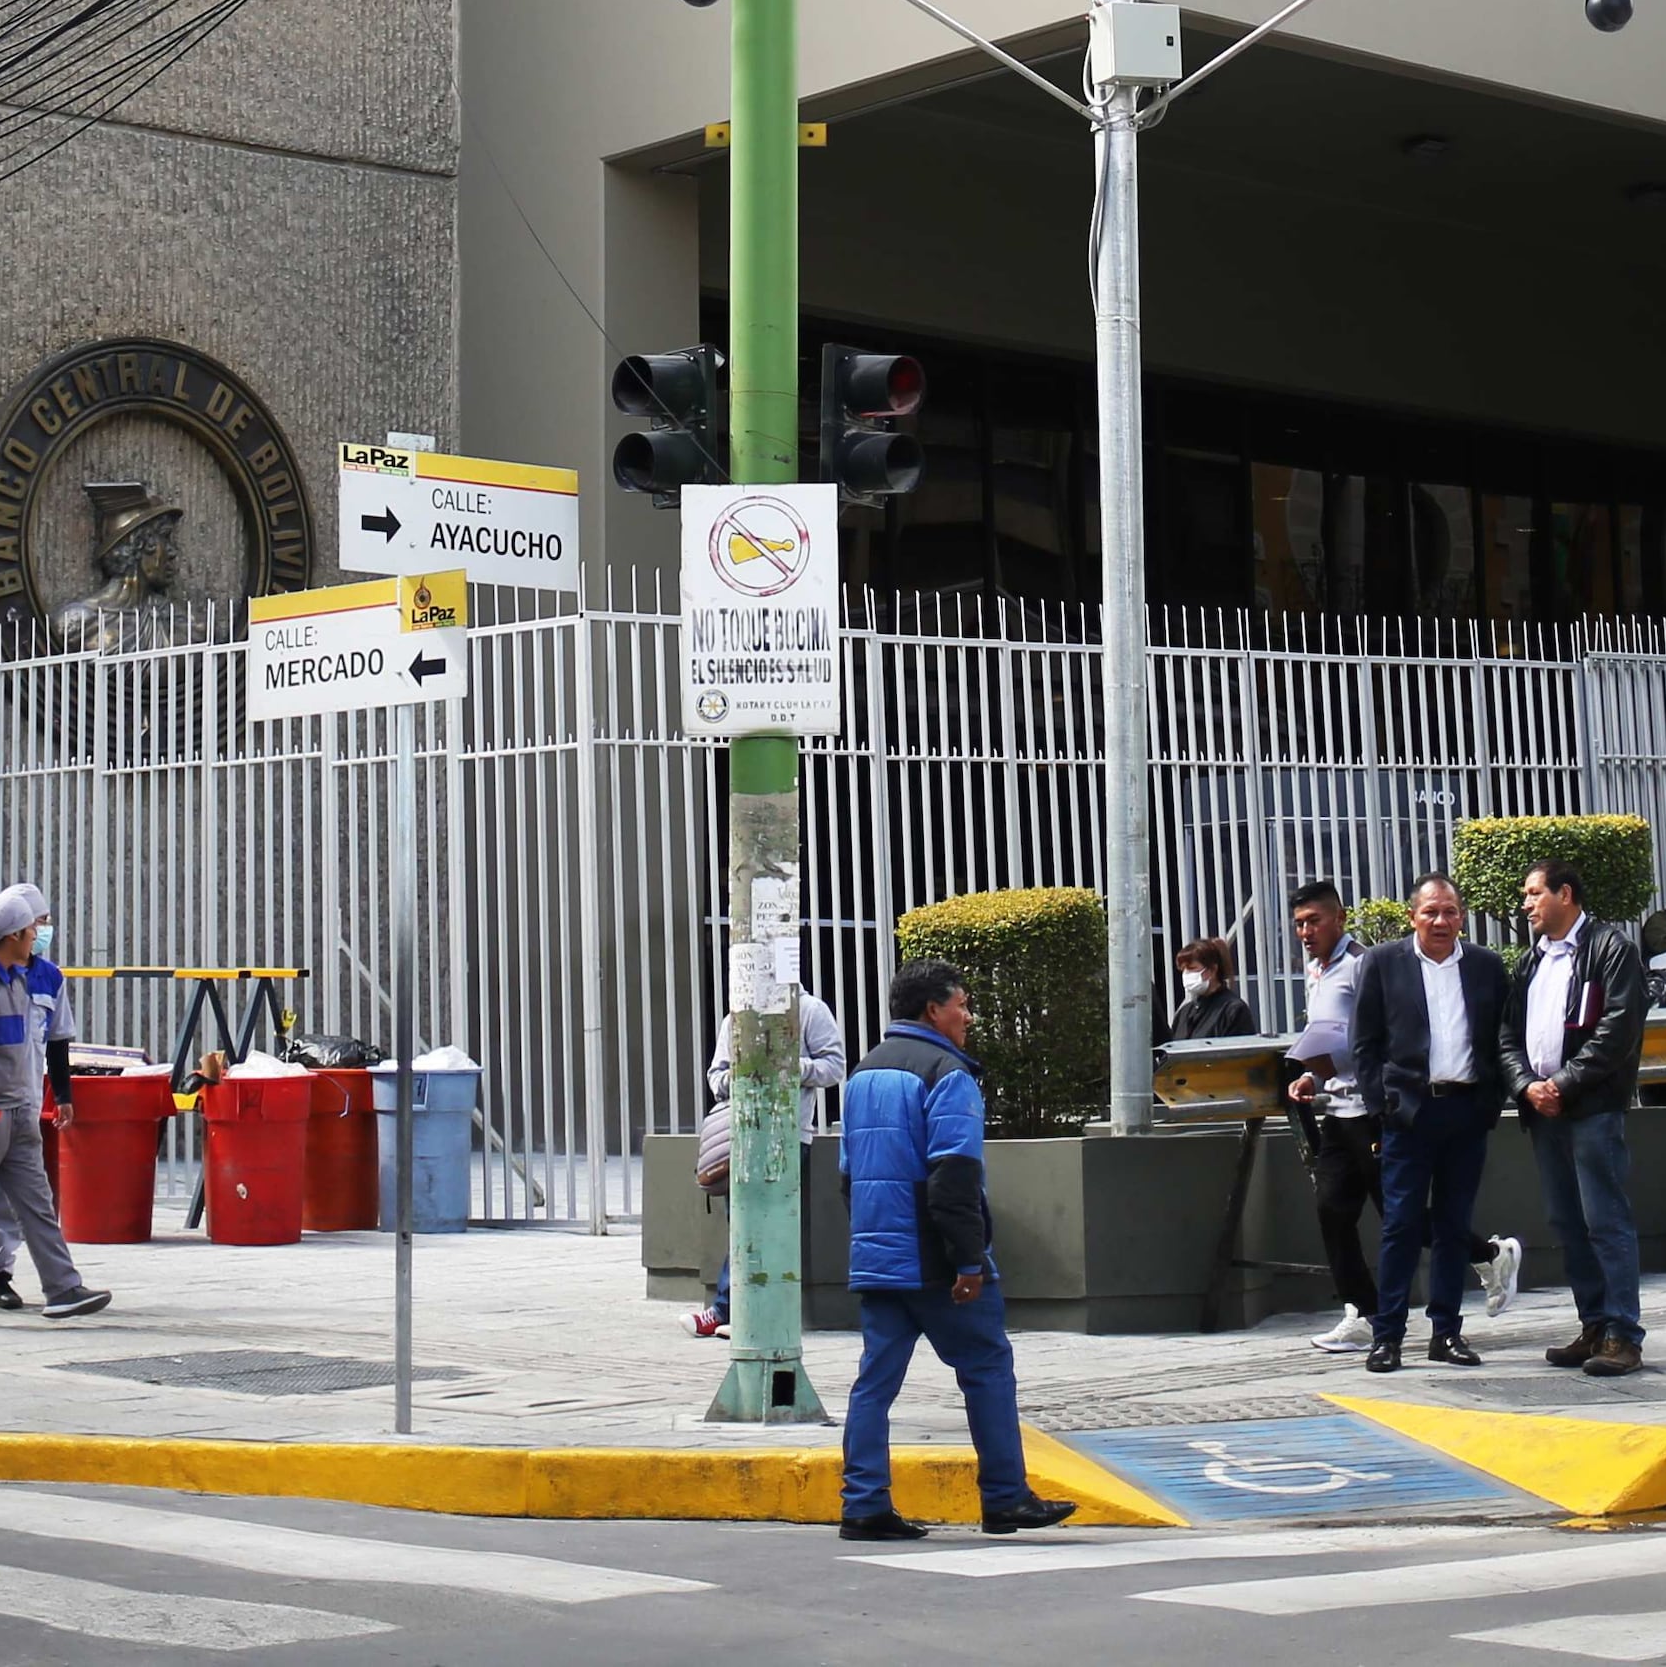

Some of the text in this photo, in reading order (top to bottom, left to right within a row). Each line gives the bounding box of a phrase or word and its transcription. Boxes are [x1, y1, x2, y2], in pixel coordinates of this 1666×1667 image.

[31, 353, 192, 436] CENTRAL
[205, 381, 255, 440] DE
[431, 487, 492, 516] CALLE:
[430, 521, 563, 562] AYACUCHO
[264, 625, 318, 652] CALLE:
[692, 608, 715, 653] NO
[719, 606, 771, 654] TOQUE
[265, 647, 384, 690] MERCADO
[691, 657, 832, 685] EL SILENCIO ES SALUD
